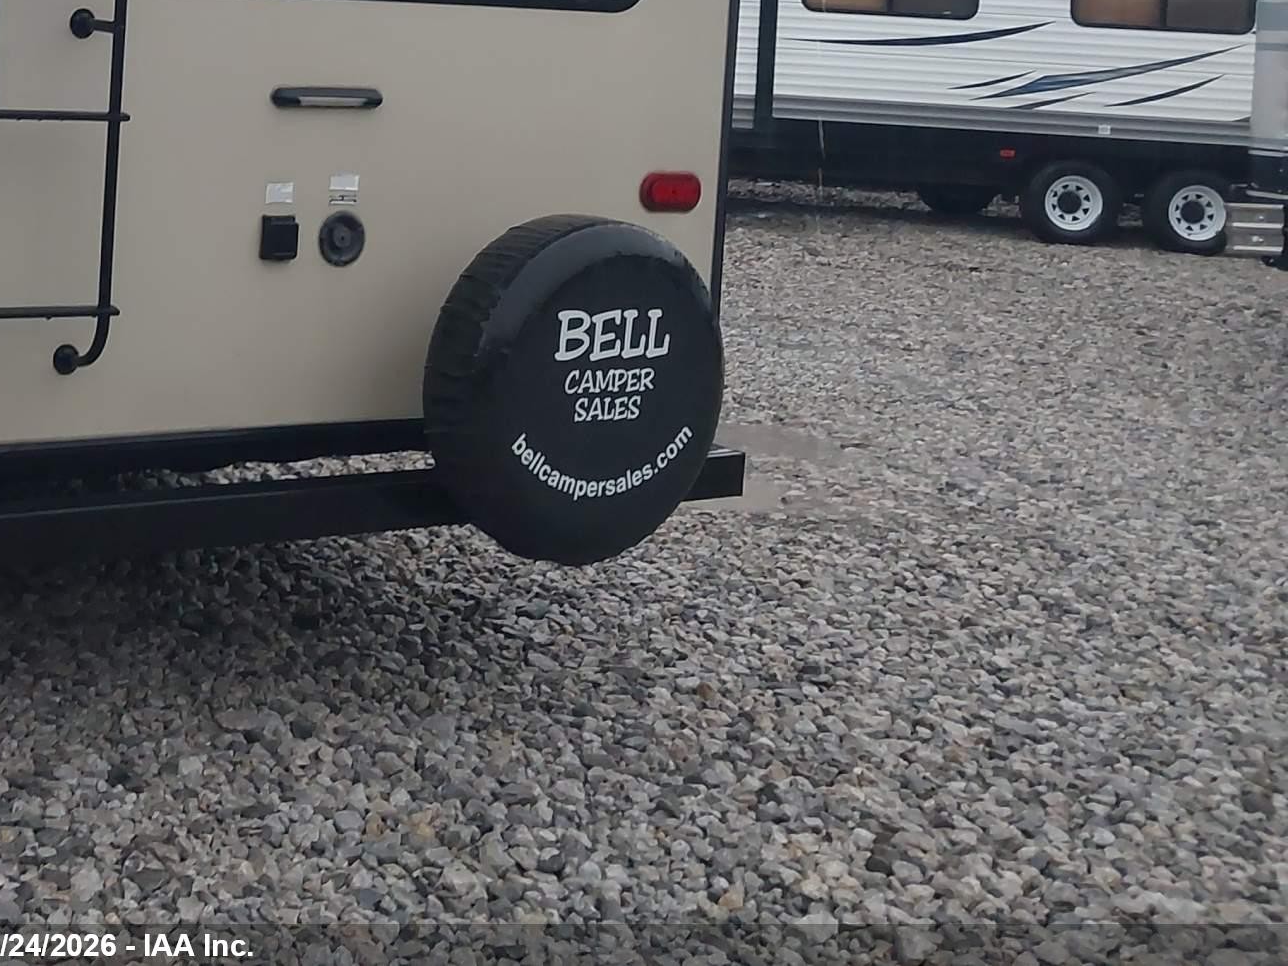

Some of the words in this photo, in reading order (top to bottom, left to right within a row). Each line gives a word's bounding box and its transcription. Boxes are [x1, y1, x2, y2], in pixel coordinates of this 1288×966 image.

[554, 308, 670, 362] BELL
[564, 367, 655, 395] CAMPER
[574, 395, 641, 422] SALES
[511, 425, 694, 501] bellcampersales.com
